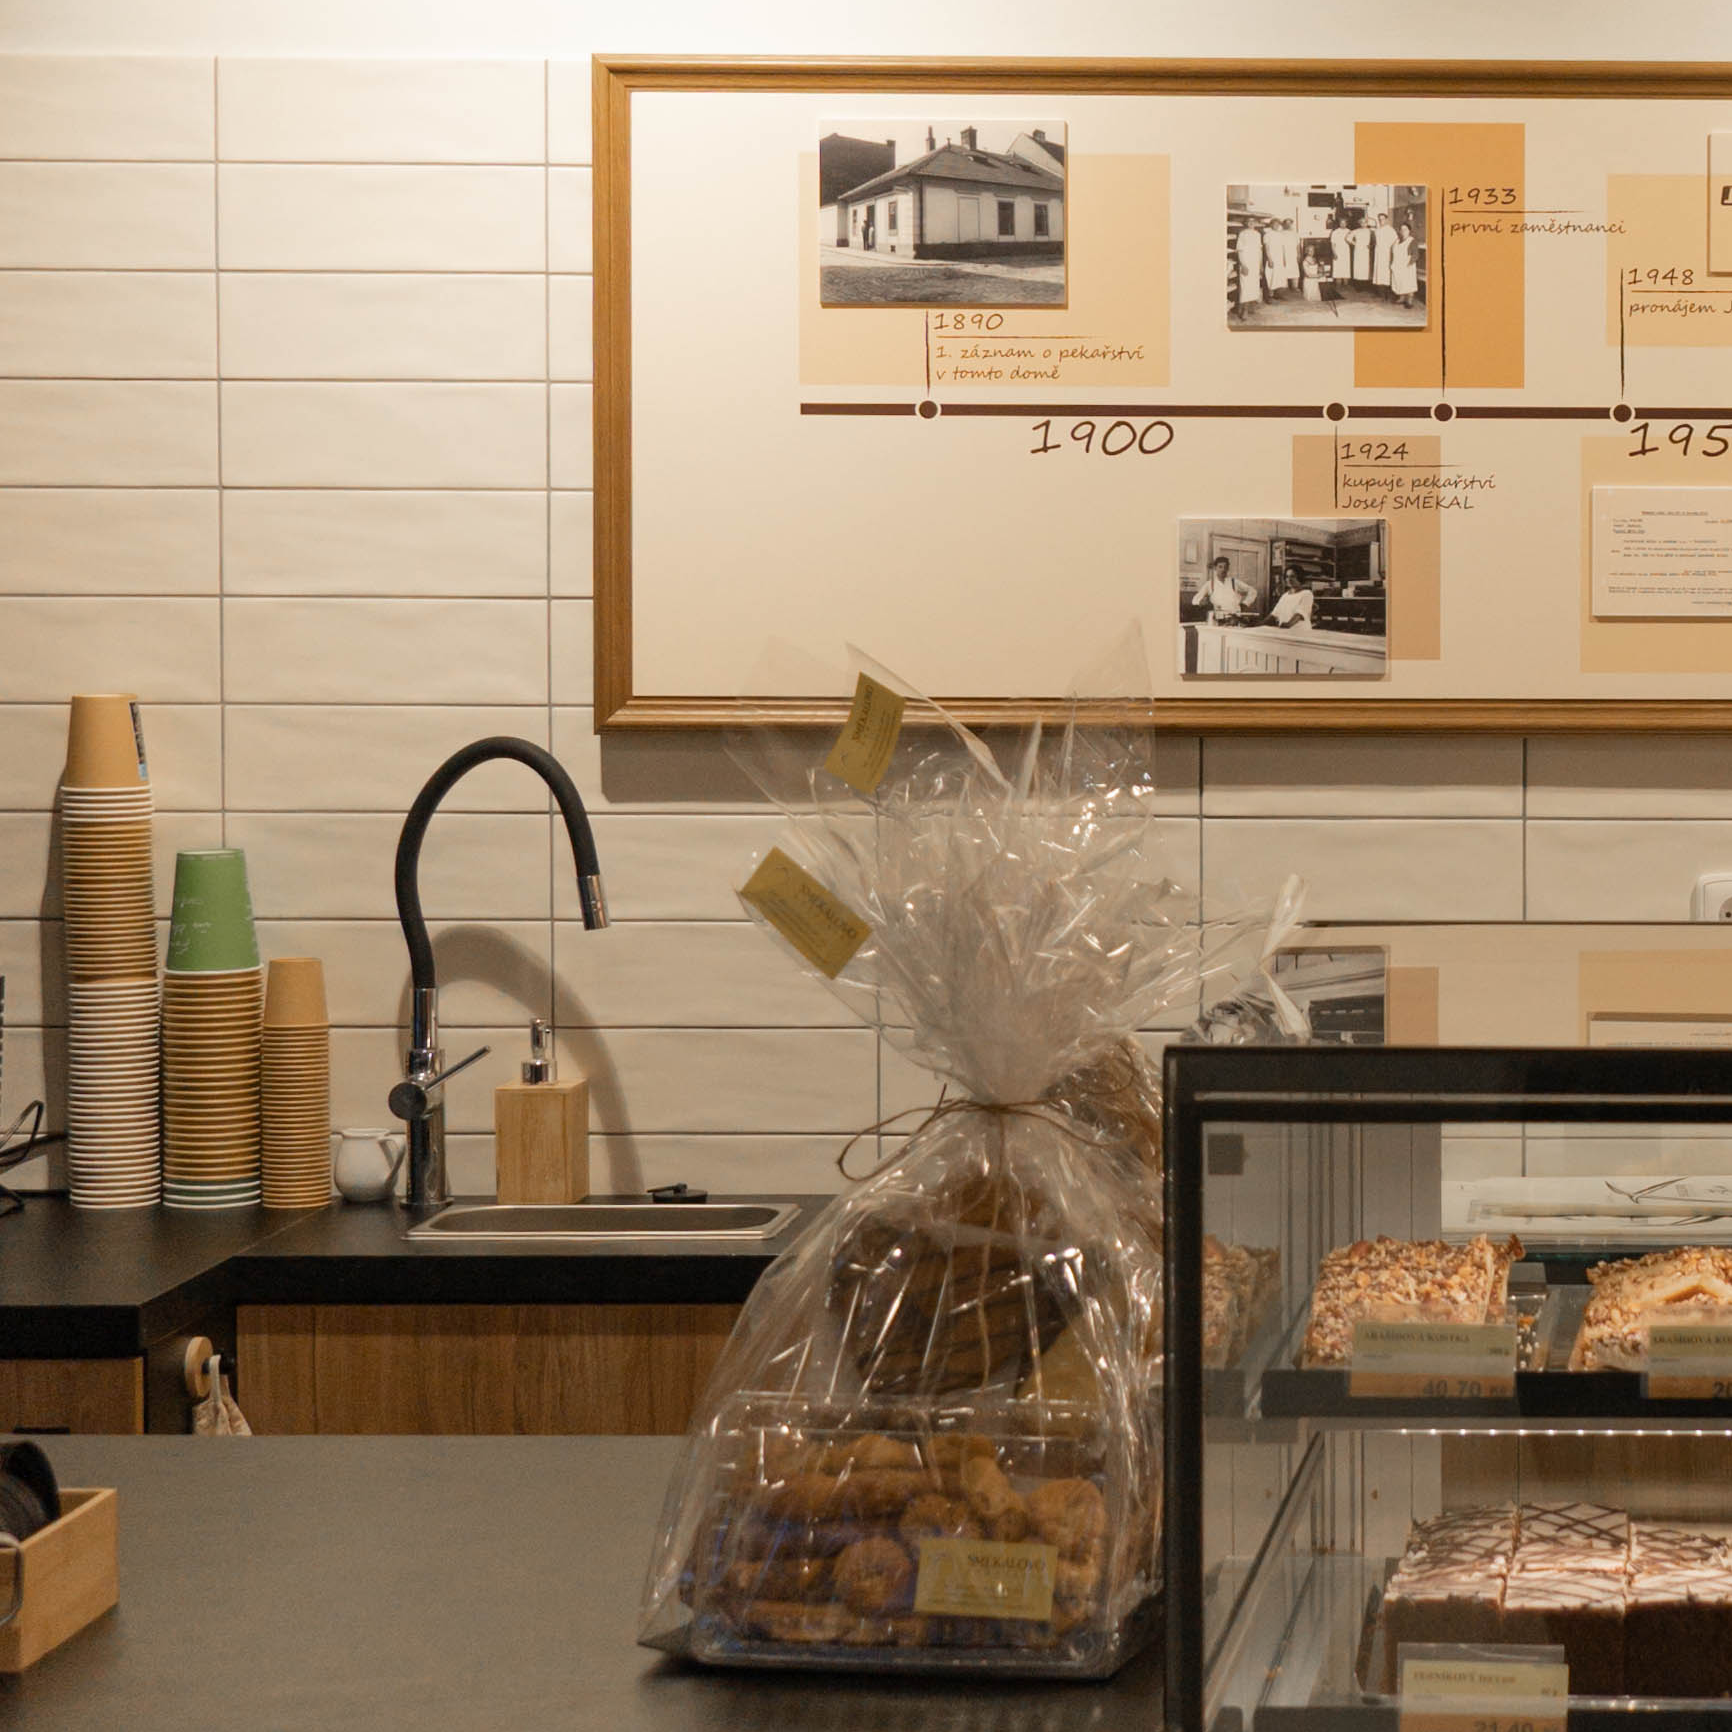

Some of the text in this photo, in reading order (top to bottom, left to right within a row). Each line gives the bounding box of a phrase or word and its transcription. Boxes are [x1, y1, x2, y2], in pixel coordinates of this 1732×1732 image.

[1448, 187, 1517, 205] 1933
[1450, 219, 1626, 237] první zaměstnanci
[1627, 268, 1694, 285] 1948
[1629, 299, 1716, 317] pronájem
[934, 313, 1003, 330] 1890
[936, 344, 1145, 363] 1. záznam o pekařství
[936, 365, 1060, 380] v tomto domě
[1030, 419, 1174, 456] 1900
[1340, 442, 1409, 460] 1924
[1342, 473, 1496, 492] kupuje pekařství
[1342, 491, 1474, 513] Josef SMÉKAL
